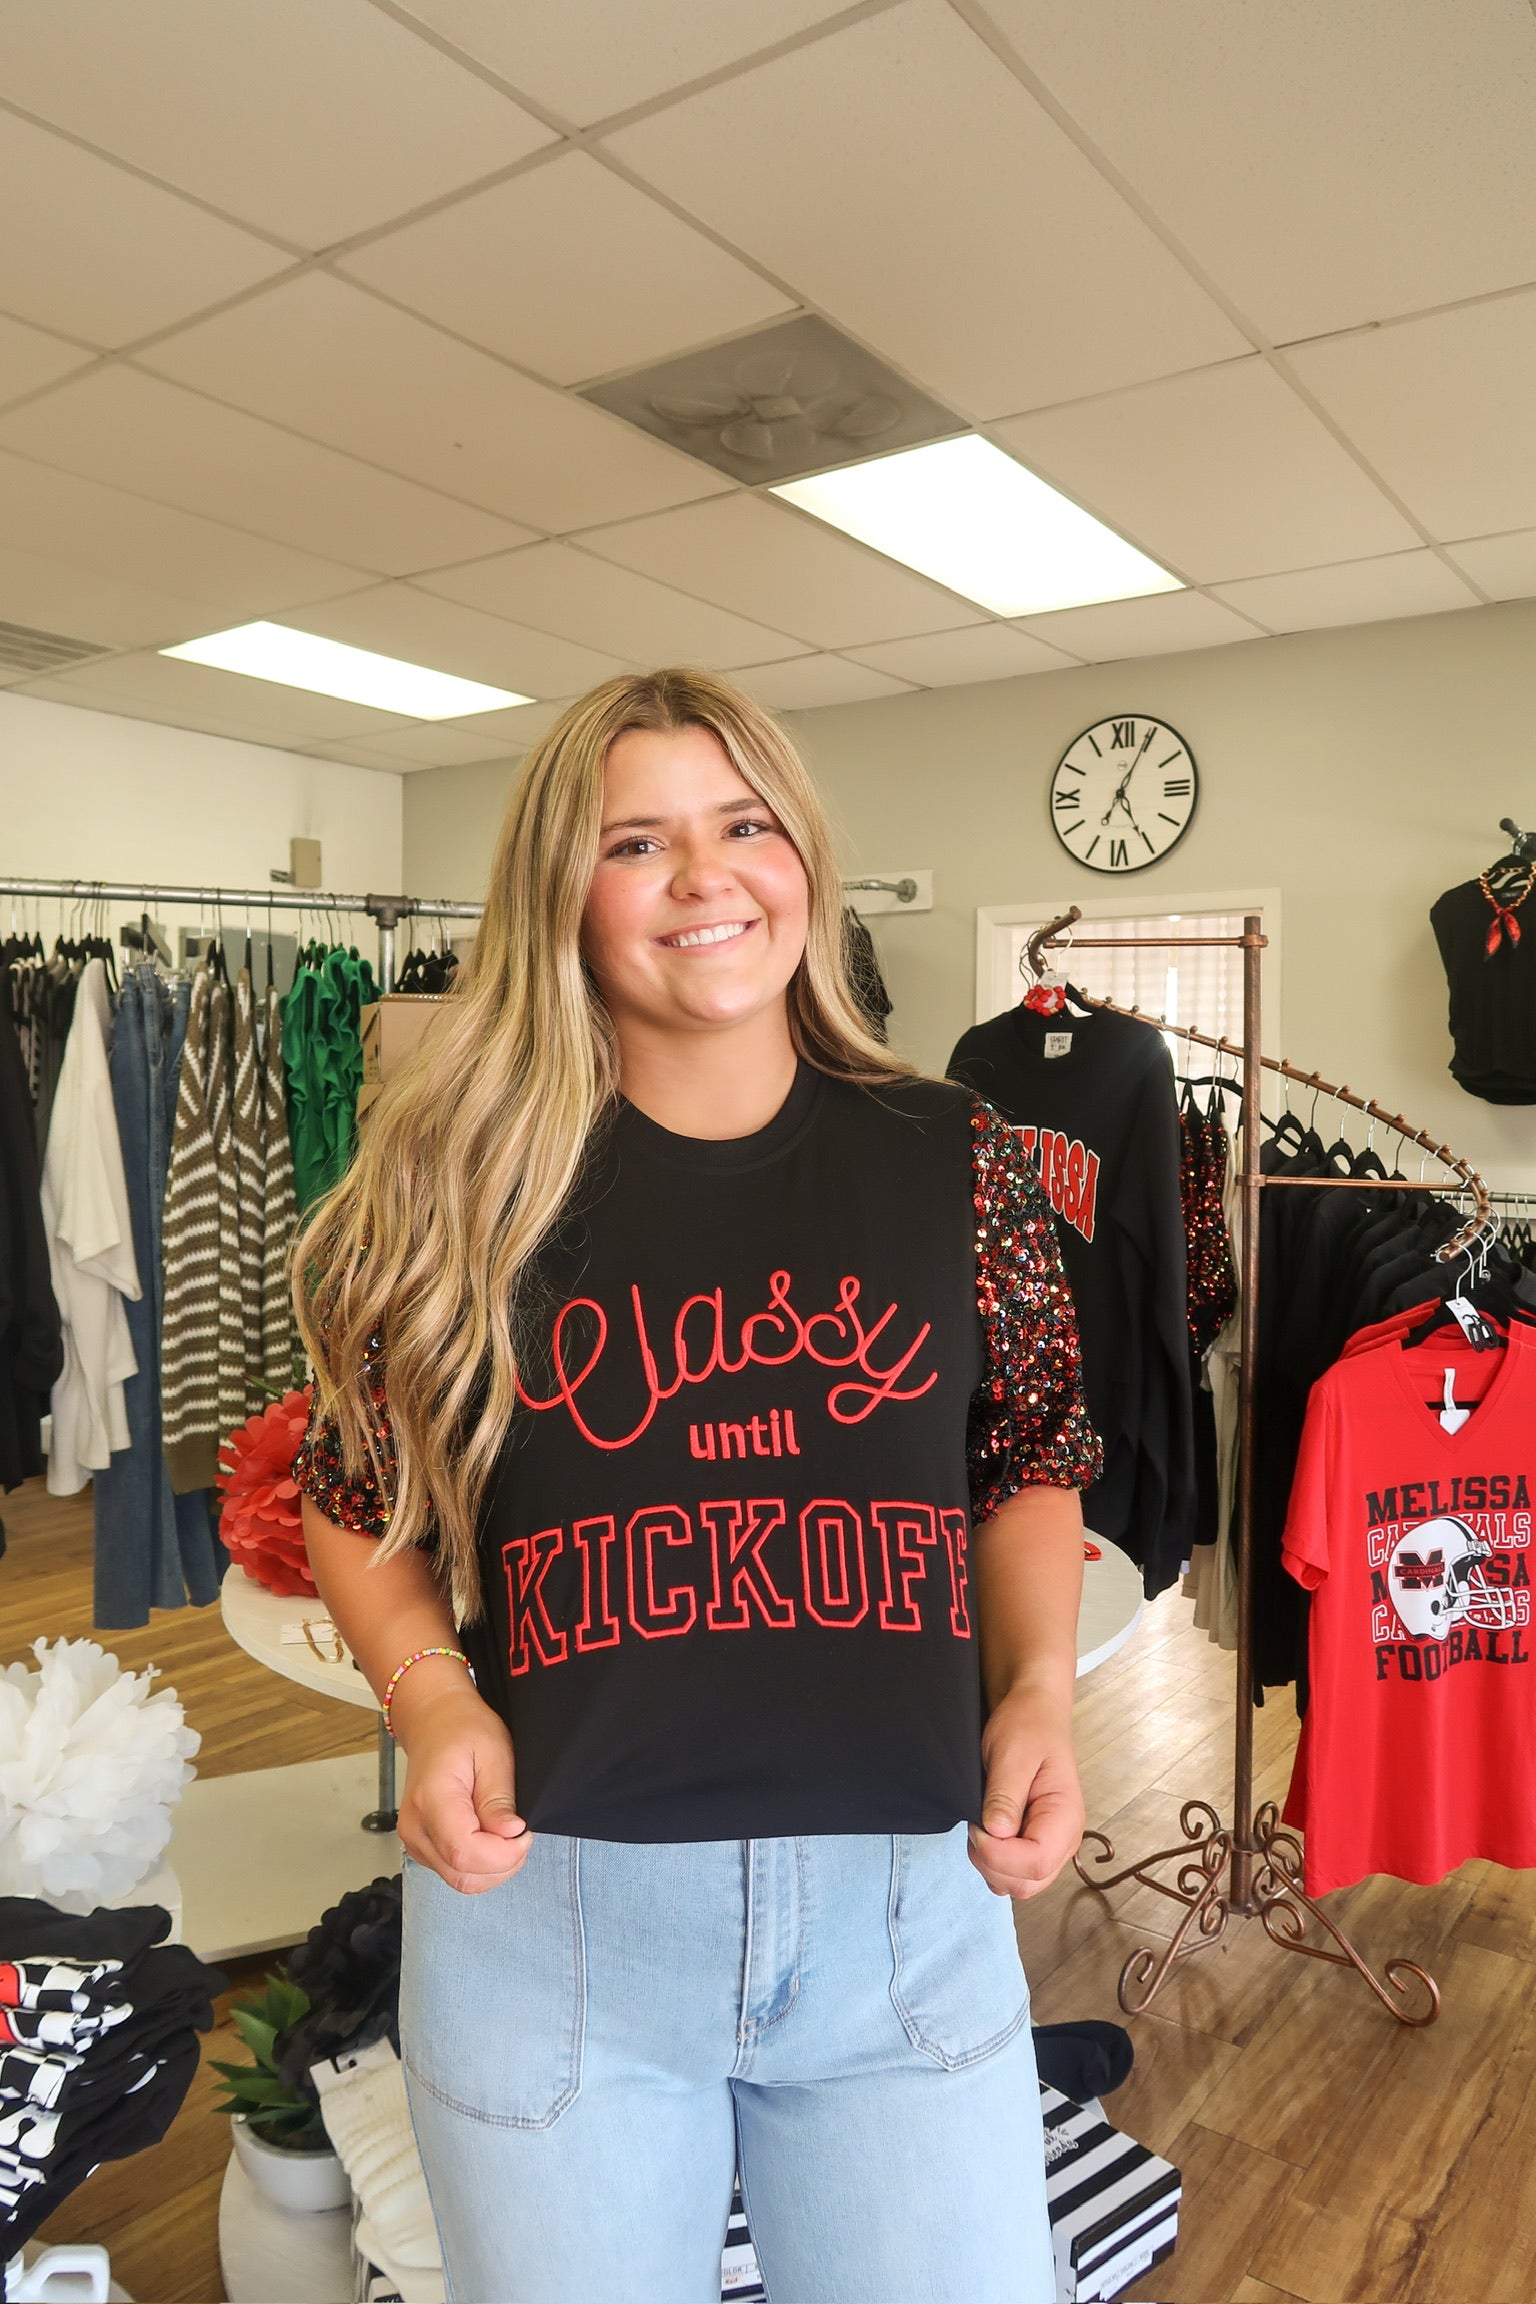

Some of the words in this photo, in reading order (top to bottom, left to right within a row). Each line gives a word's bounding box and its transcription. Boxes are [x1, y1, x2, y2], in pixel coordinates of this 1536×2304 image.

[1111, 721, 1135, 749] XII
[513, 1270, 938, 1450] Classy
[689, 1409, 801, 1460] until
[1366, 1475, 1531, 1527] MELISSA
[1367, 1512, 1532, 1568] CAALS
[1375, 1630, 1529, 1682] FOOTBALL
